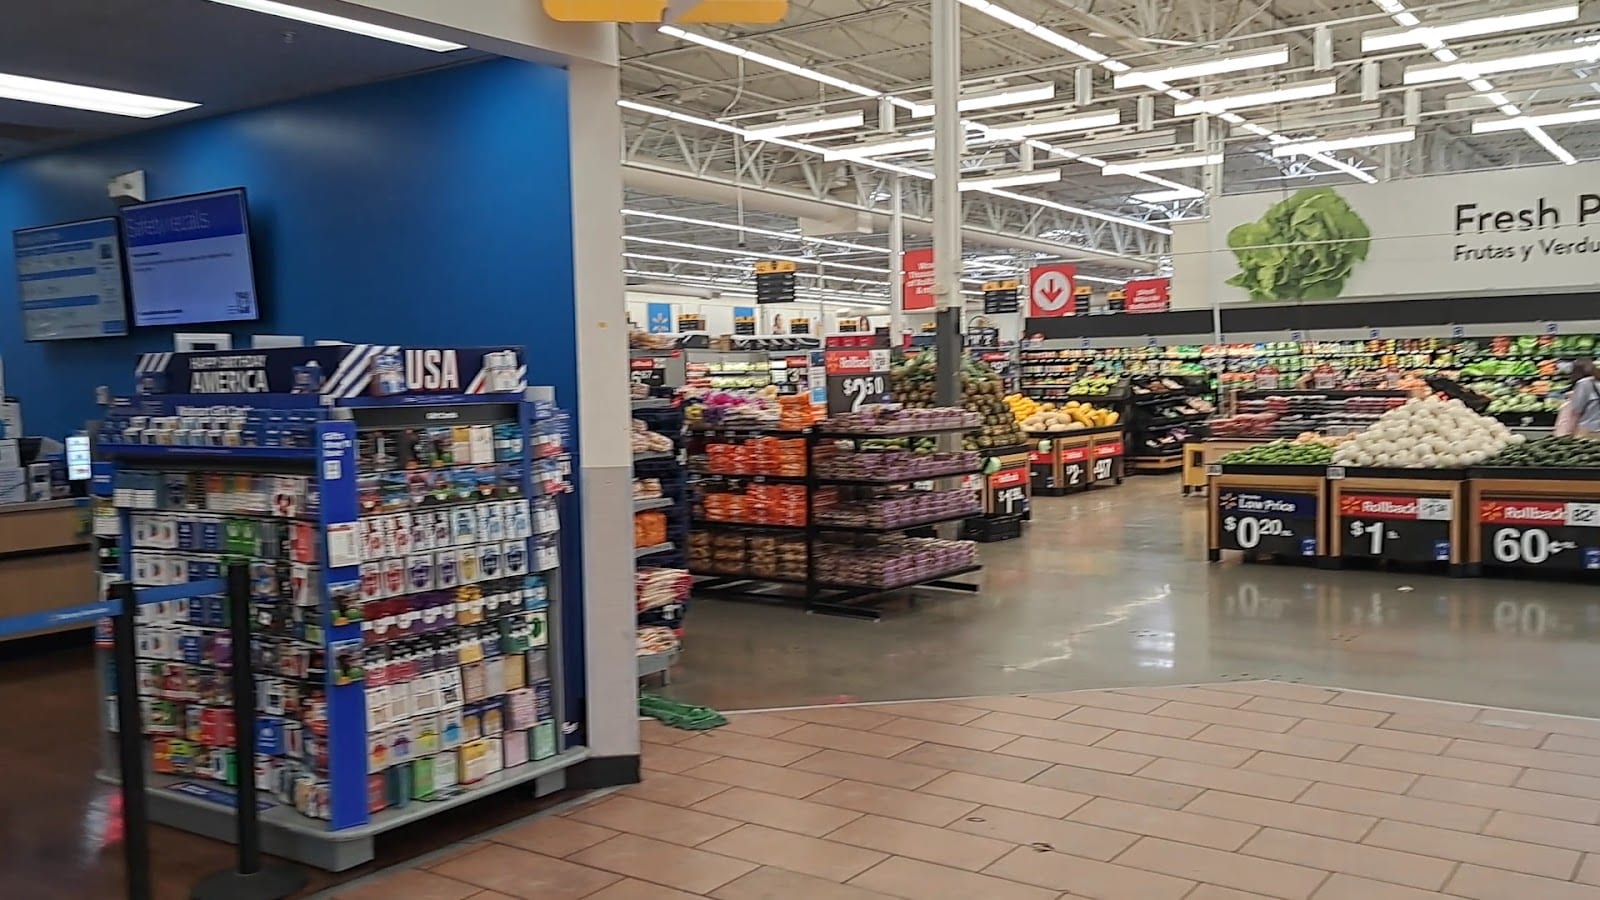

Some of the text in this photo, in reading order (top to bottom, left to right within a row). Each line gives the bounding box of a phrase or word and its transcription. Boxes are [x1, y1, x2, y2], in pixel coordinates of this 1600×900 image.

[1456, 198, 1559, 234] Fresh
[1454, 245, 1516, 261] Frutas
[1521, 244, 1534, 262] y
[404, 349, 459, 390] USA
[190, 370, 269, 394] AMERICA
[1238, 498, 1296, 512] Low Price
[1361, 501, 1419, 514] Rollback
[1504, 507, 1568, 520] Rollback
